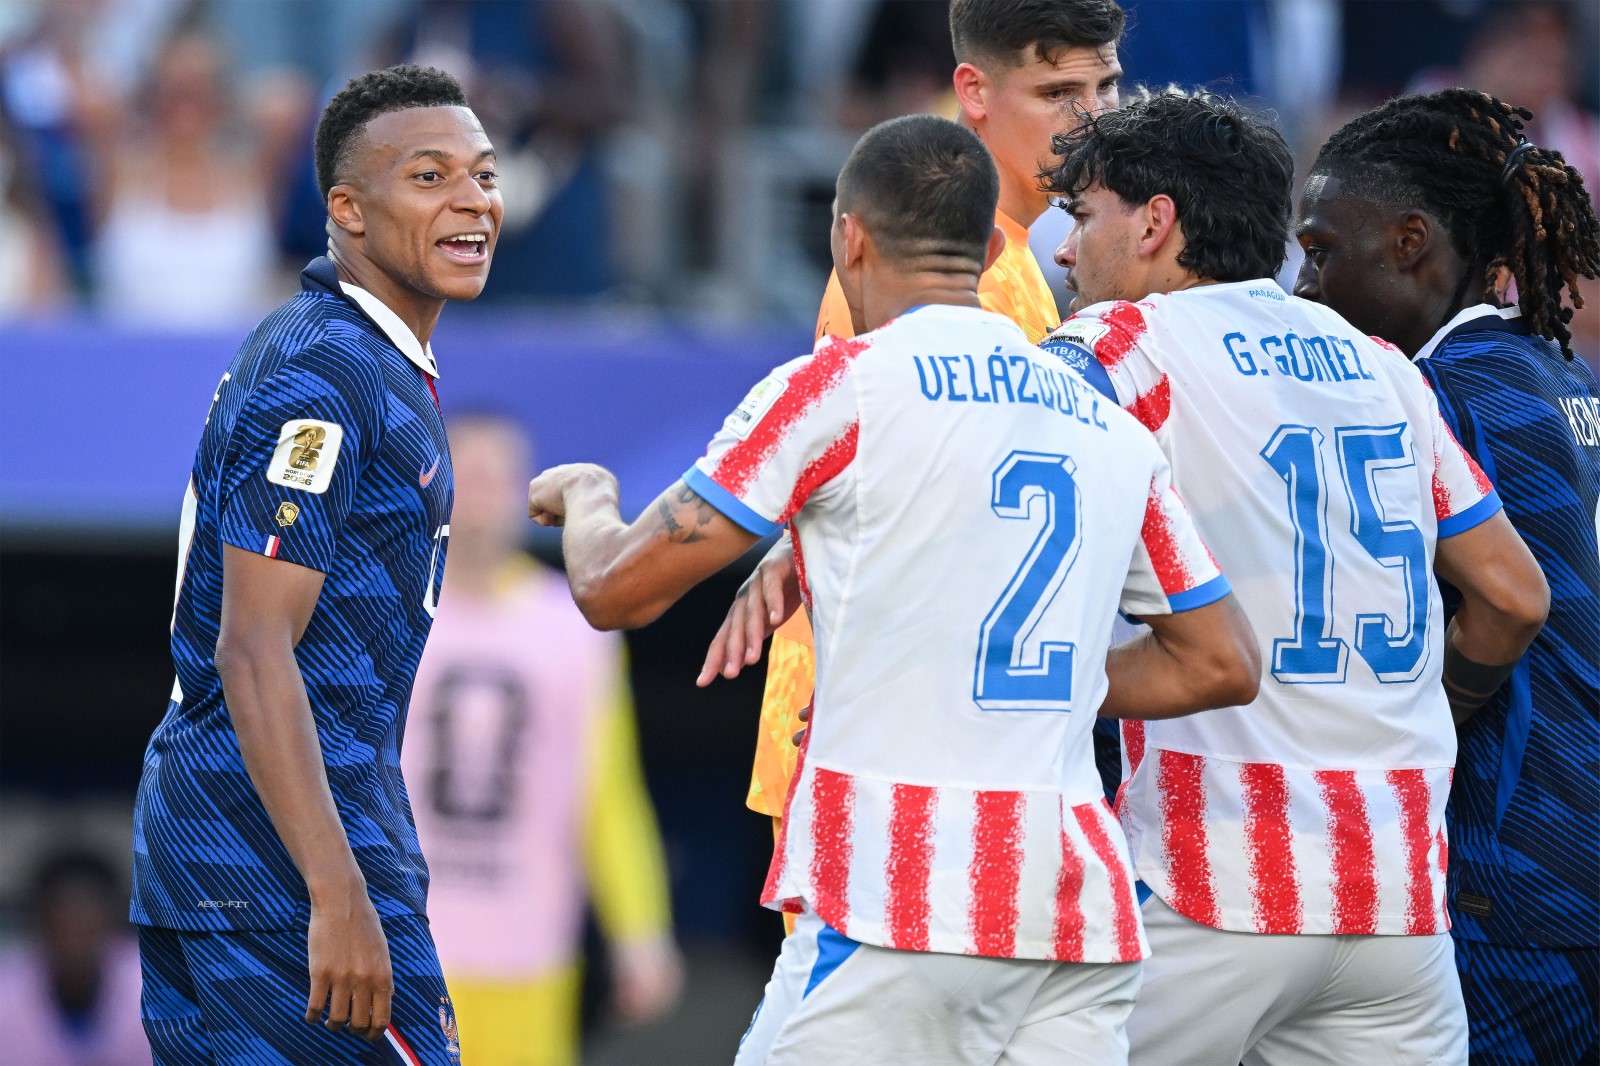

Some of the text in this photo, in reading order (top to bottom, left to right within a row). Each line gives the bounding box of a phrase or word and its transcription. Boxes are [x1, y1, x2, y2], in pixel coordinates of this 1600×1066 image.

[1248, 289, 1286, 301] PARAGUA
[912, 346, 1108, 432] VELÁZQUEZ
[283, 474, 312, 486] 2026
[1259, 421, 1431, 684] 15
[973, 449, 1083, 711] 2
[197, 900, 250, 909] AERO-FIT
